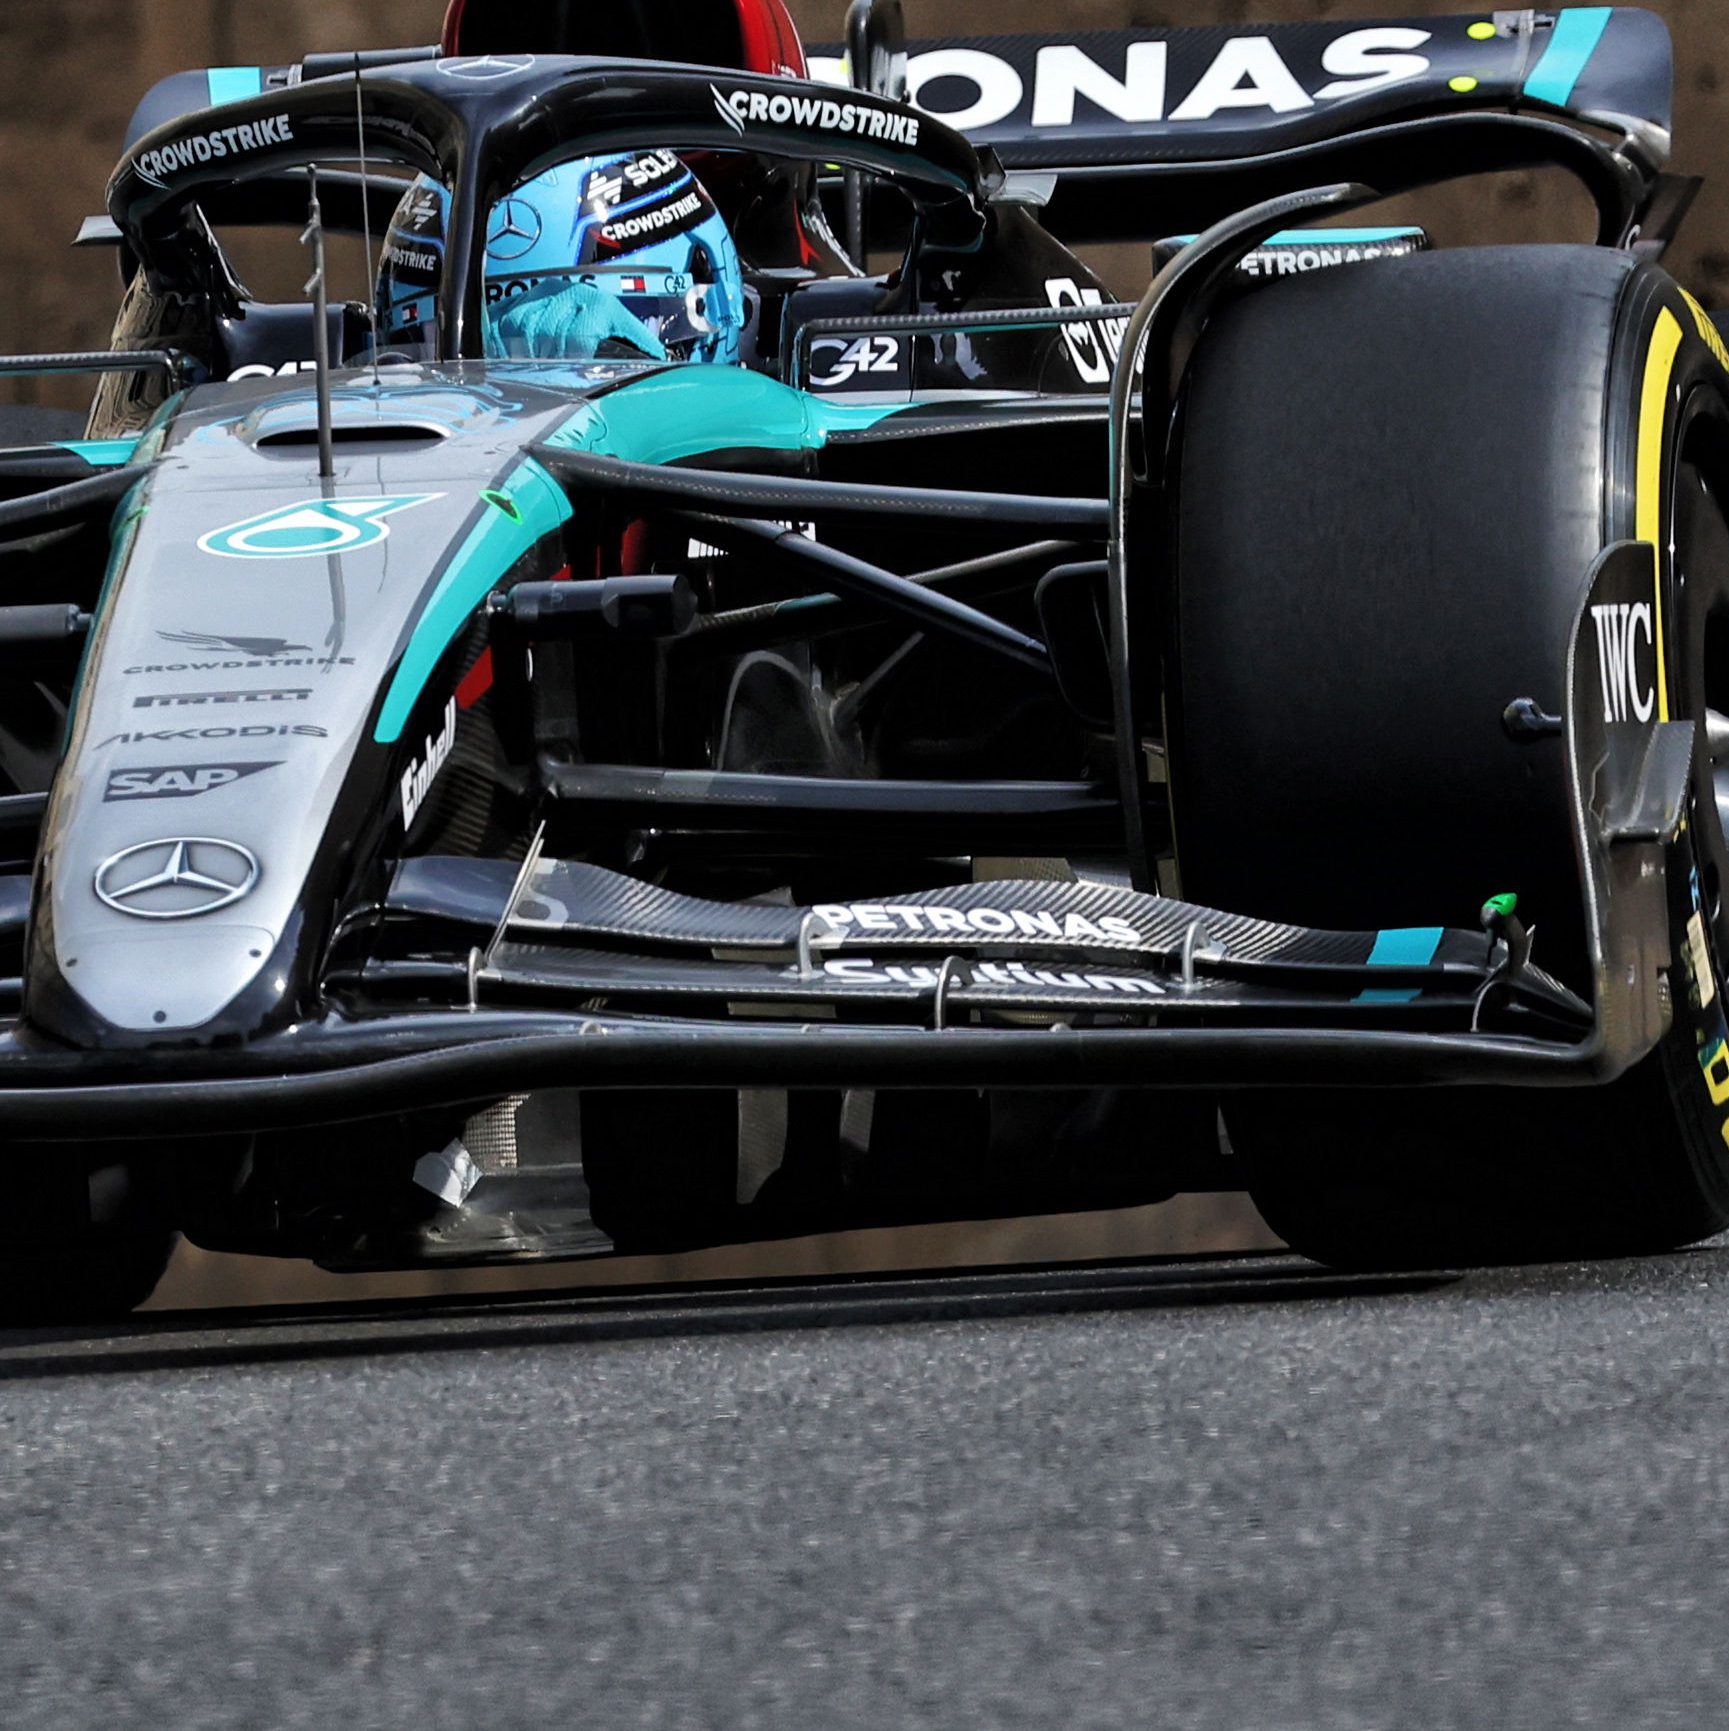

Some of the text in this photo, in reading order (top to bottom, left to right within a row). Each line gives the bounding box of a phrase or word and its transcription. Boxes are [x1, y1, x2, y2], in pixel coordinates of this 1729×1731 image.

[729, 88, 920, 147] CROWDSTRIKE
[139, 113, 295, 180] CROWDSTRIKE
[601, 191, 703, 242] CROWDSTRIKE
[122, 656, 356, 675] CROWDSTRIKE
[1590, 602, 1655, 724] IWC
[132, 688, 314, 709] PIRELLI
[109, 768, 240, 795] SAP
[400, 695, 457, 833] Einhell
[811, 904, 1142, 943] PETRONAS
